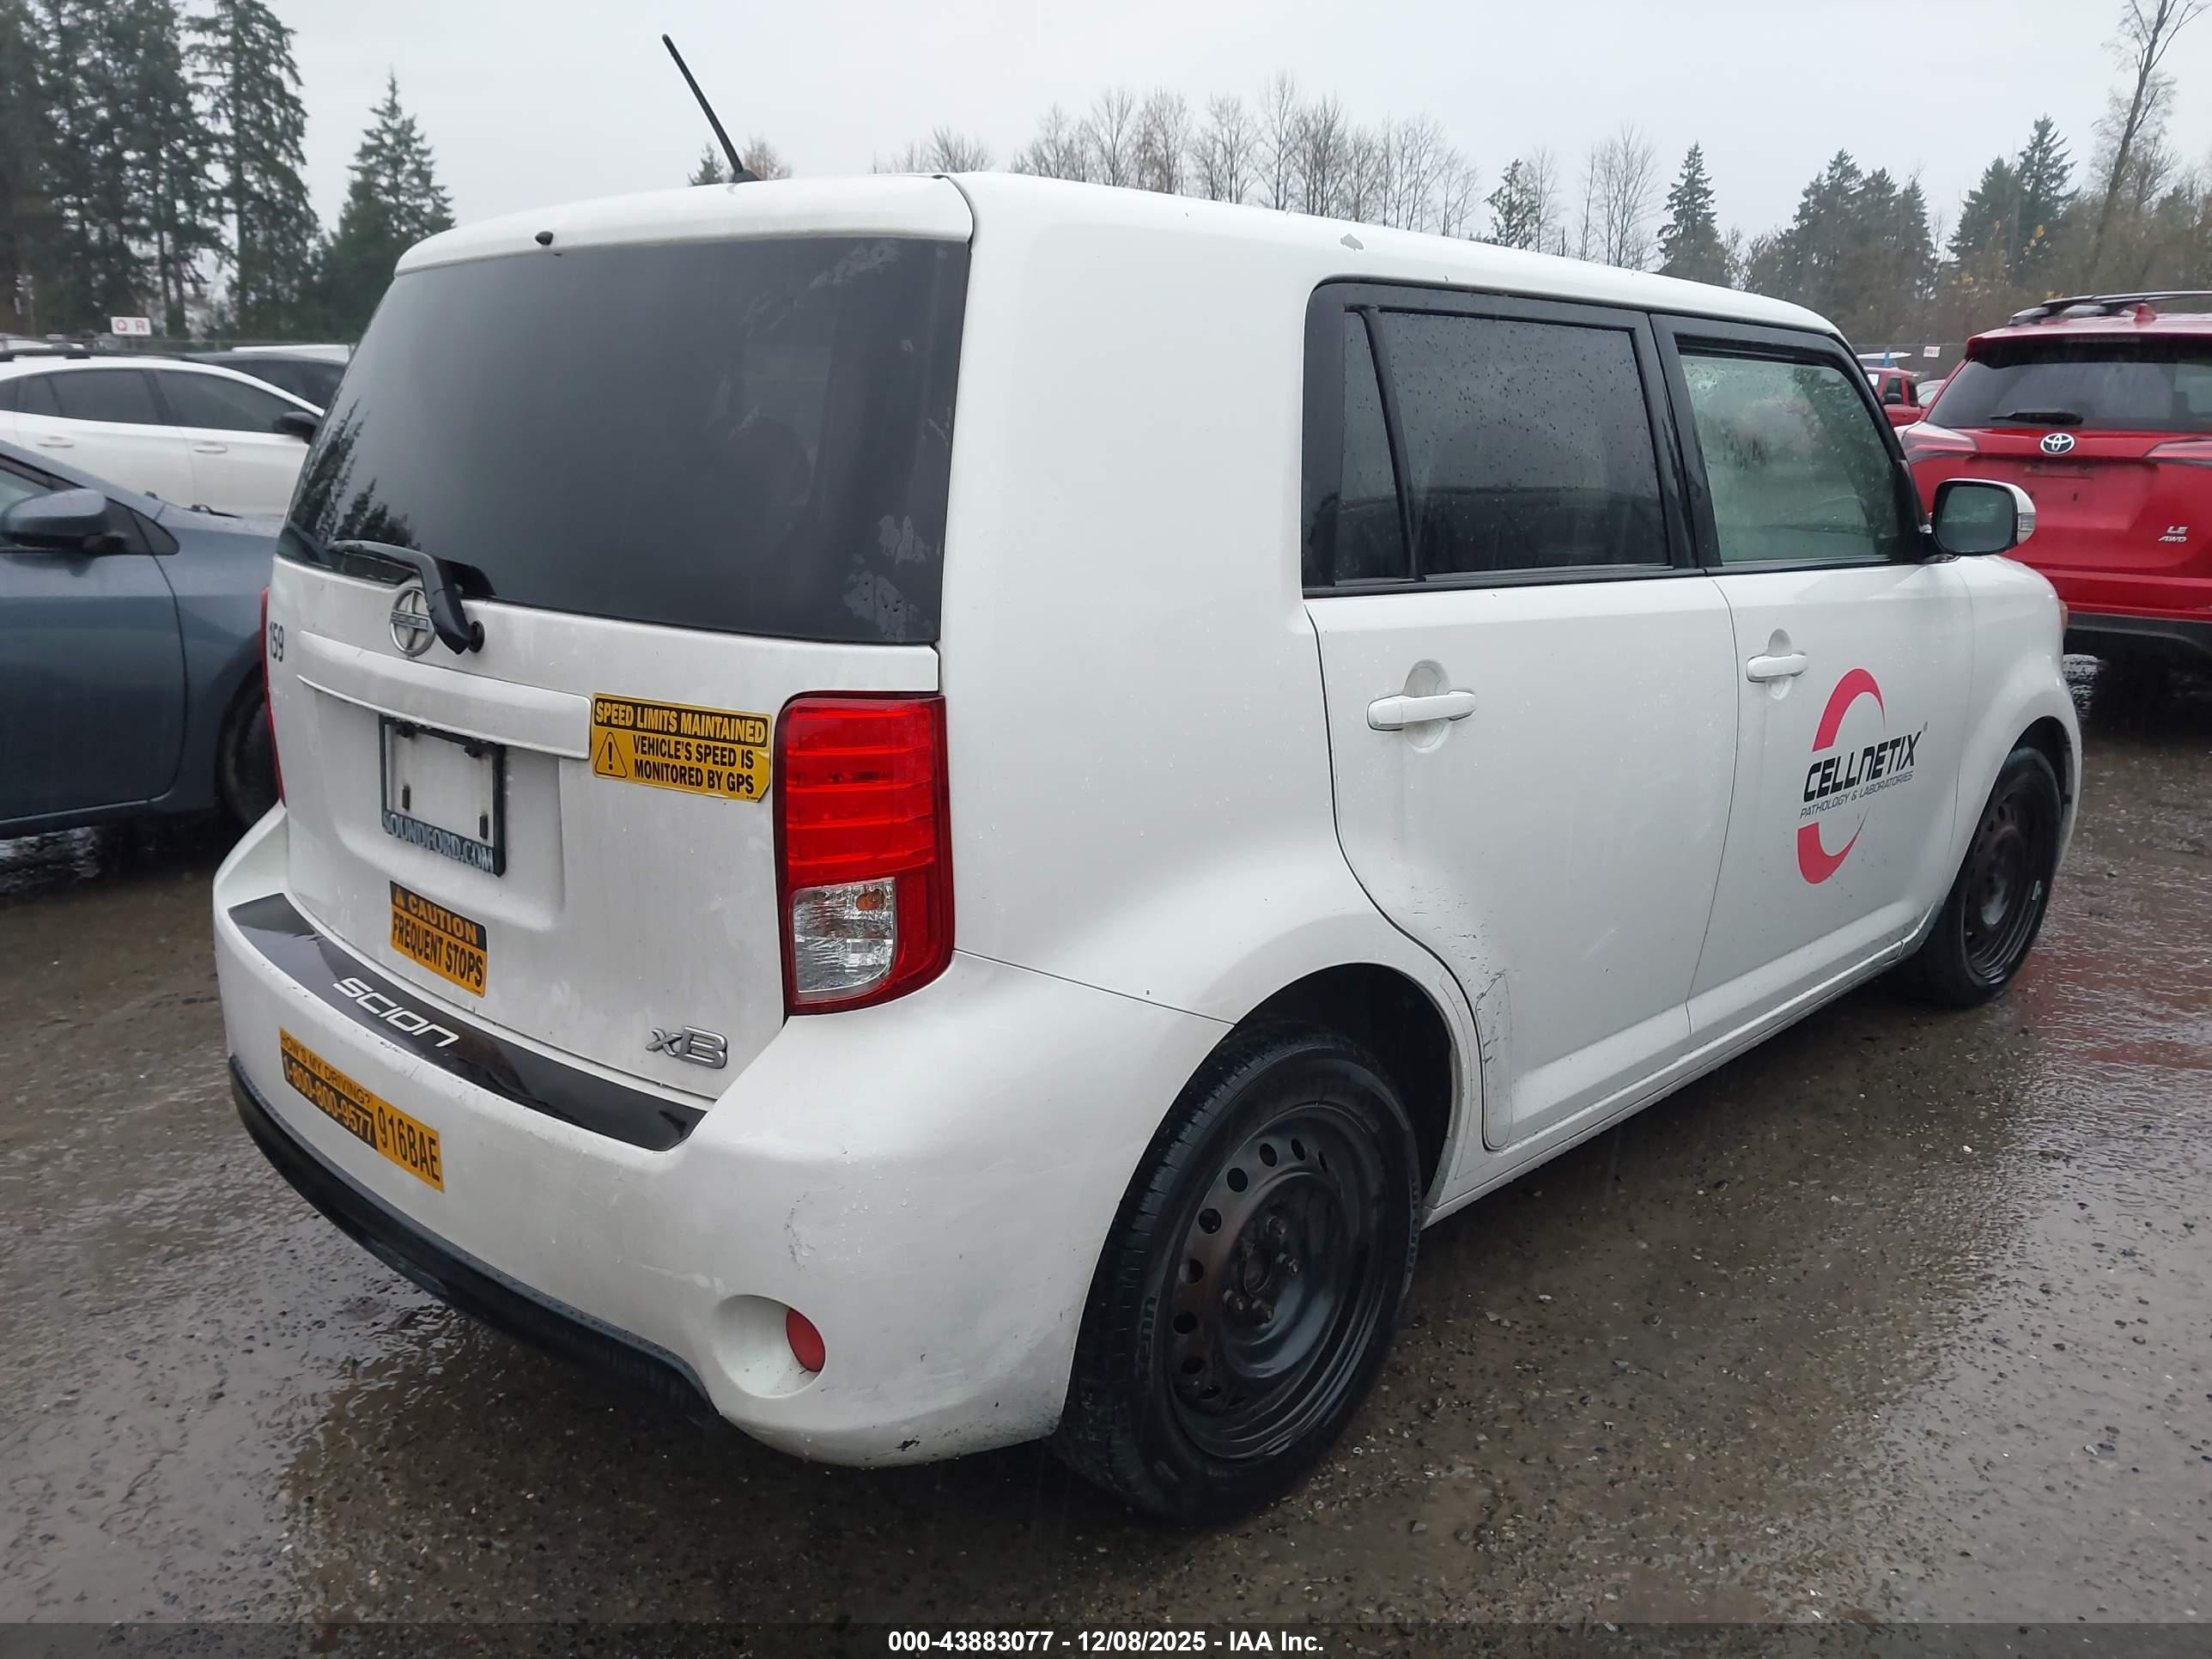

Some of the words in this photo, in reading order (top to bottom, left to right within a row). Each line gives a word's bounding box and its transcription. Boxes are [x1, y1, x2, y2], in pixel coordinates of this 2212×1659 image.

[136, 319, 145, 332] R
[2166, 526, 2188, 534] LE
[269, 621, 284, 662] 159
[596, 701, 635, 726] SPEED
[636, 706, 678, 734] LIMITS
[681, 712, 766, 744] MAINTAINED
[632, 734, 692, 762] VEHICLE'S
[696, 743, 737, 768] SPEED
[741, 750, 754, 770] IS
[1803, 731, 1923, 803] CELLNETIX
[634, 758, 704, 787] MONITORED
[708, 769, 724, 790] BY
[727, 774, 754, 794] GPS
[1800, 793, 1850, 819] PATHOLOGY
[1851, 788, 1858, 801] &
[1859, 771, 1914, 799] LABORATORIES
[408, 894, 477, 945] CAUTION
[392, 915, 444, 970] FREQUENT
[446, 940, 483, 988] STOPS
[645, 1024, 727, 1069] xB
[377, 1105, 441, 1182] 916BAE
